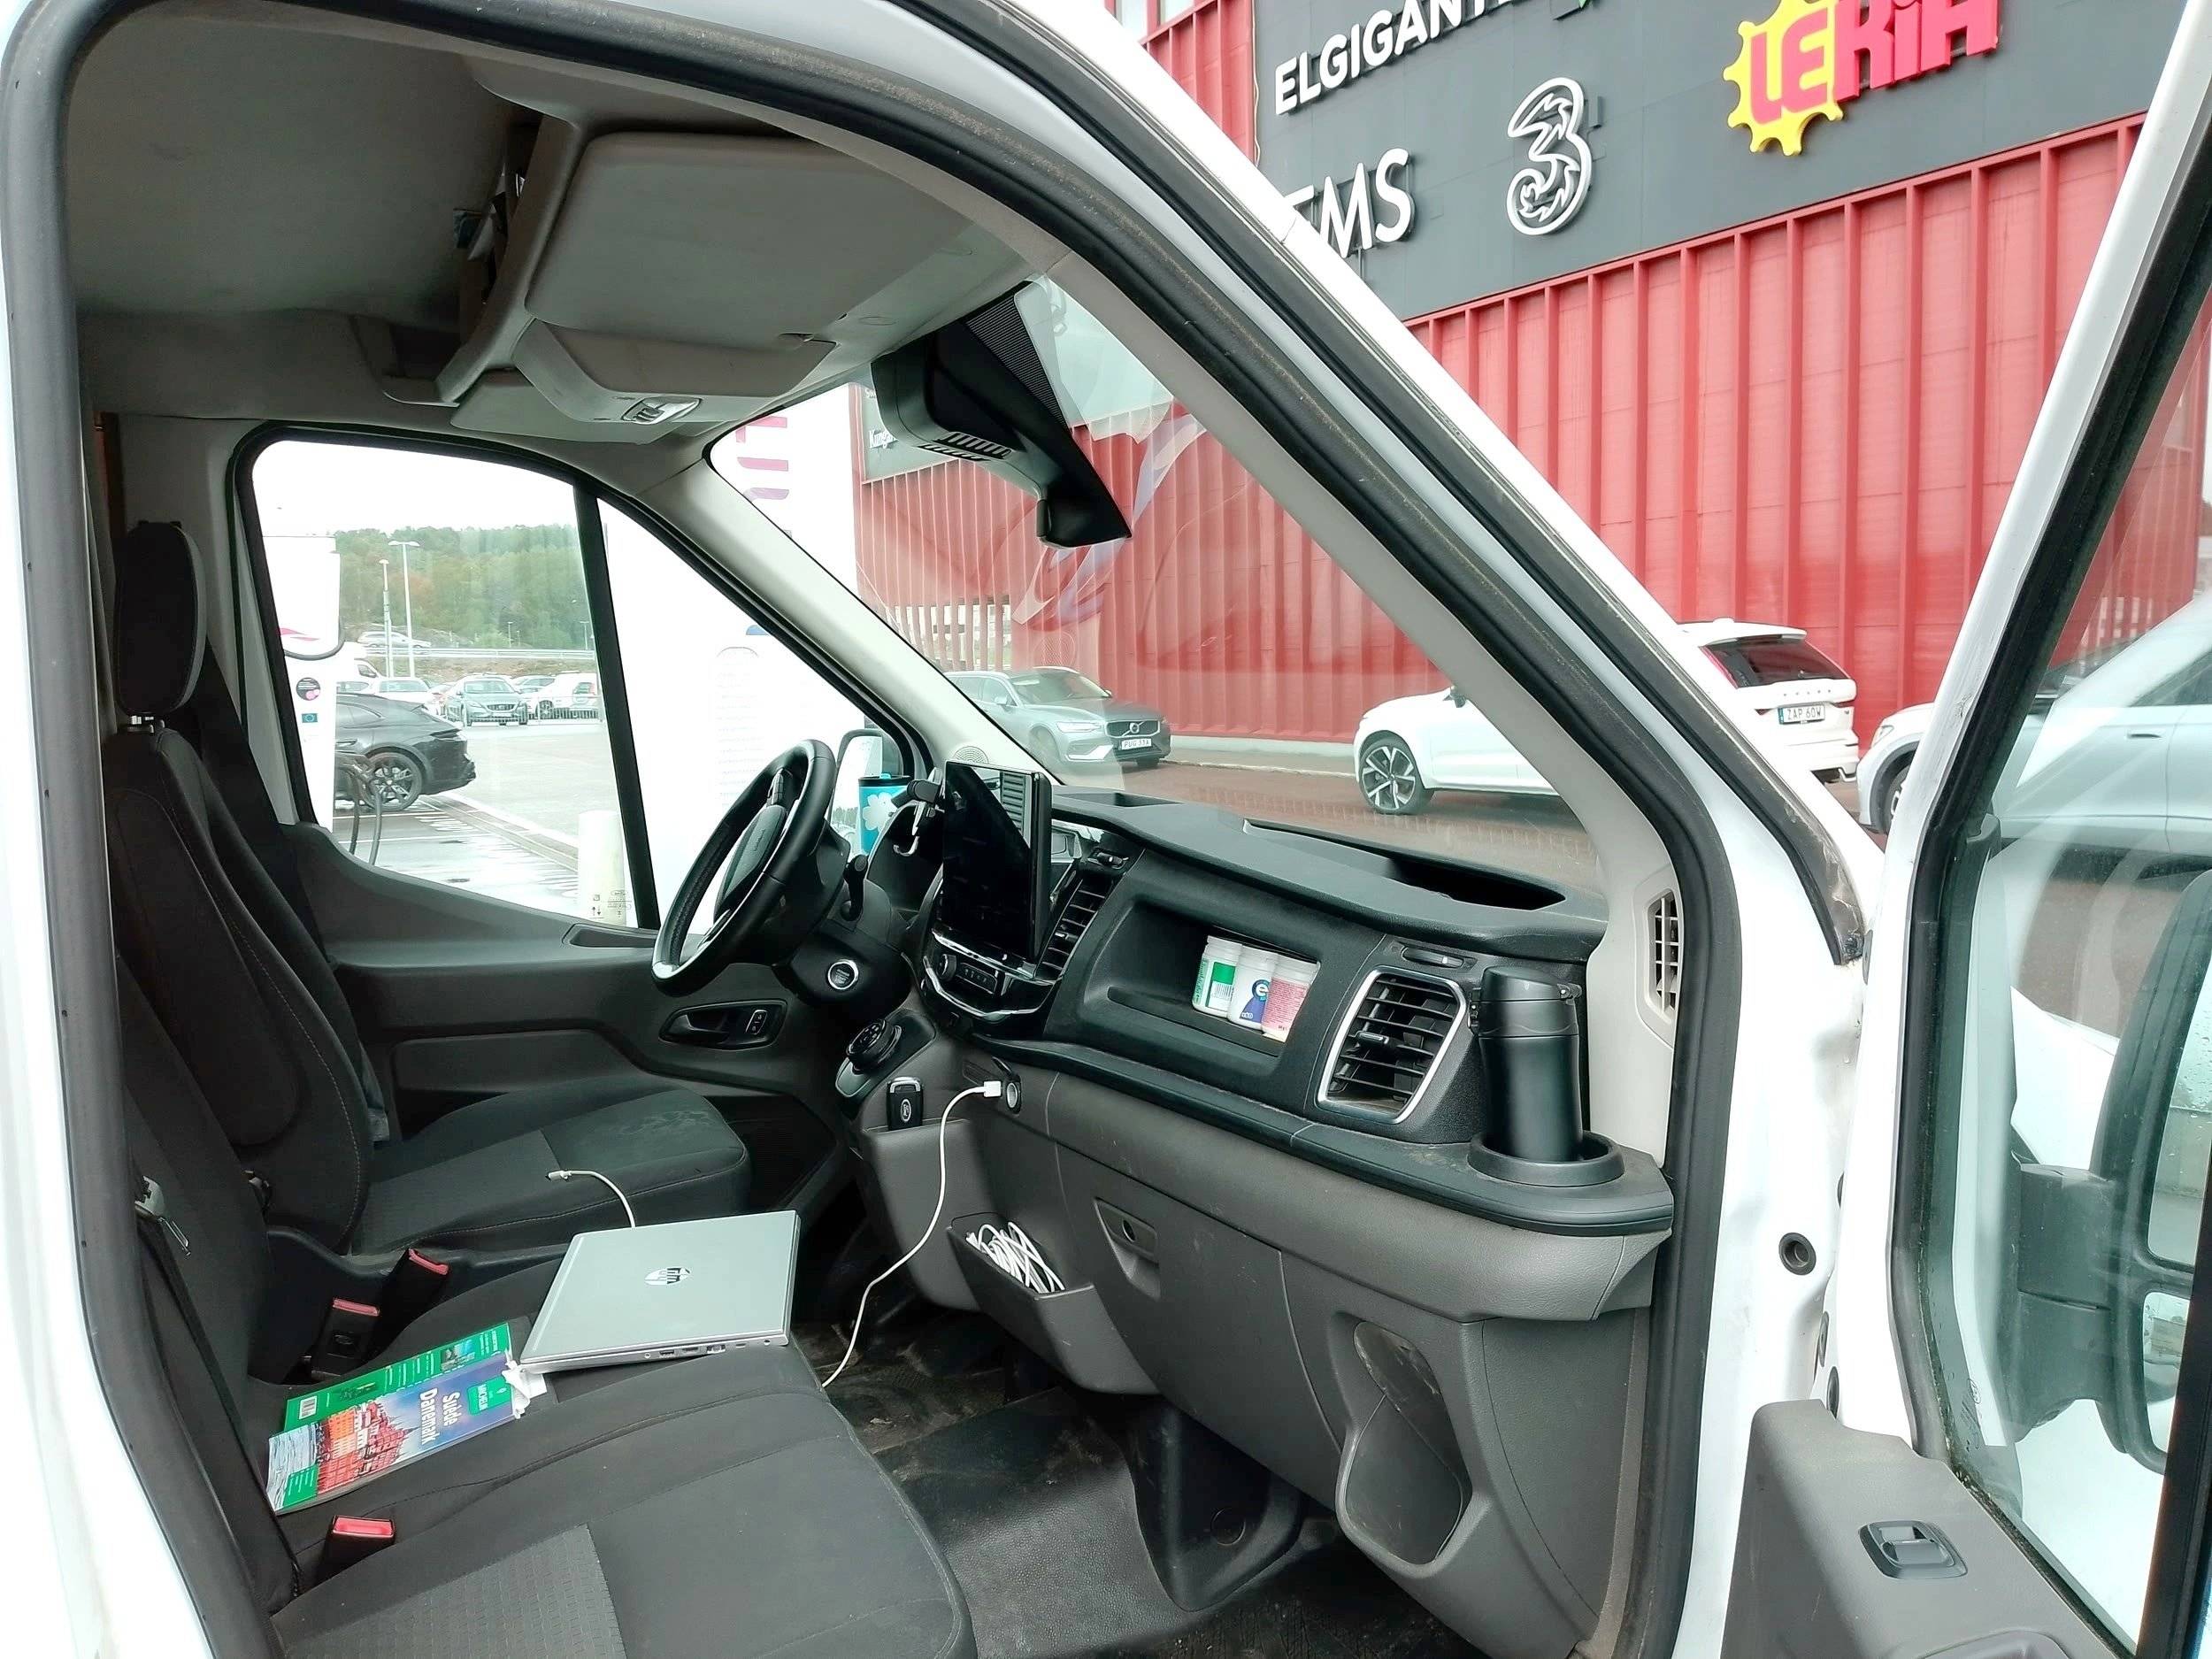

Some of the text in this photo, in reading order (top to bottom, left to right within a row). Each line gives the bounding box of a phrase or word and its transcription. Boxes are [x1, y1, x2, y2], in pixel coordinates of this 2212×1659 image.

[1285, 147, 1412, 259] MS
[419, 1387, 441, 1445] Danemark
[442, 1392, 463, 1426] Suède
